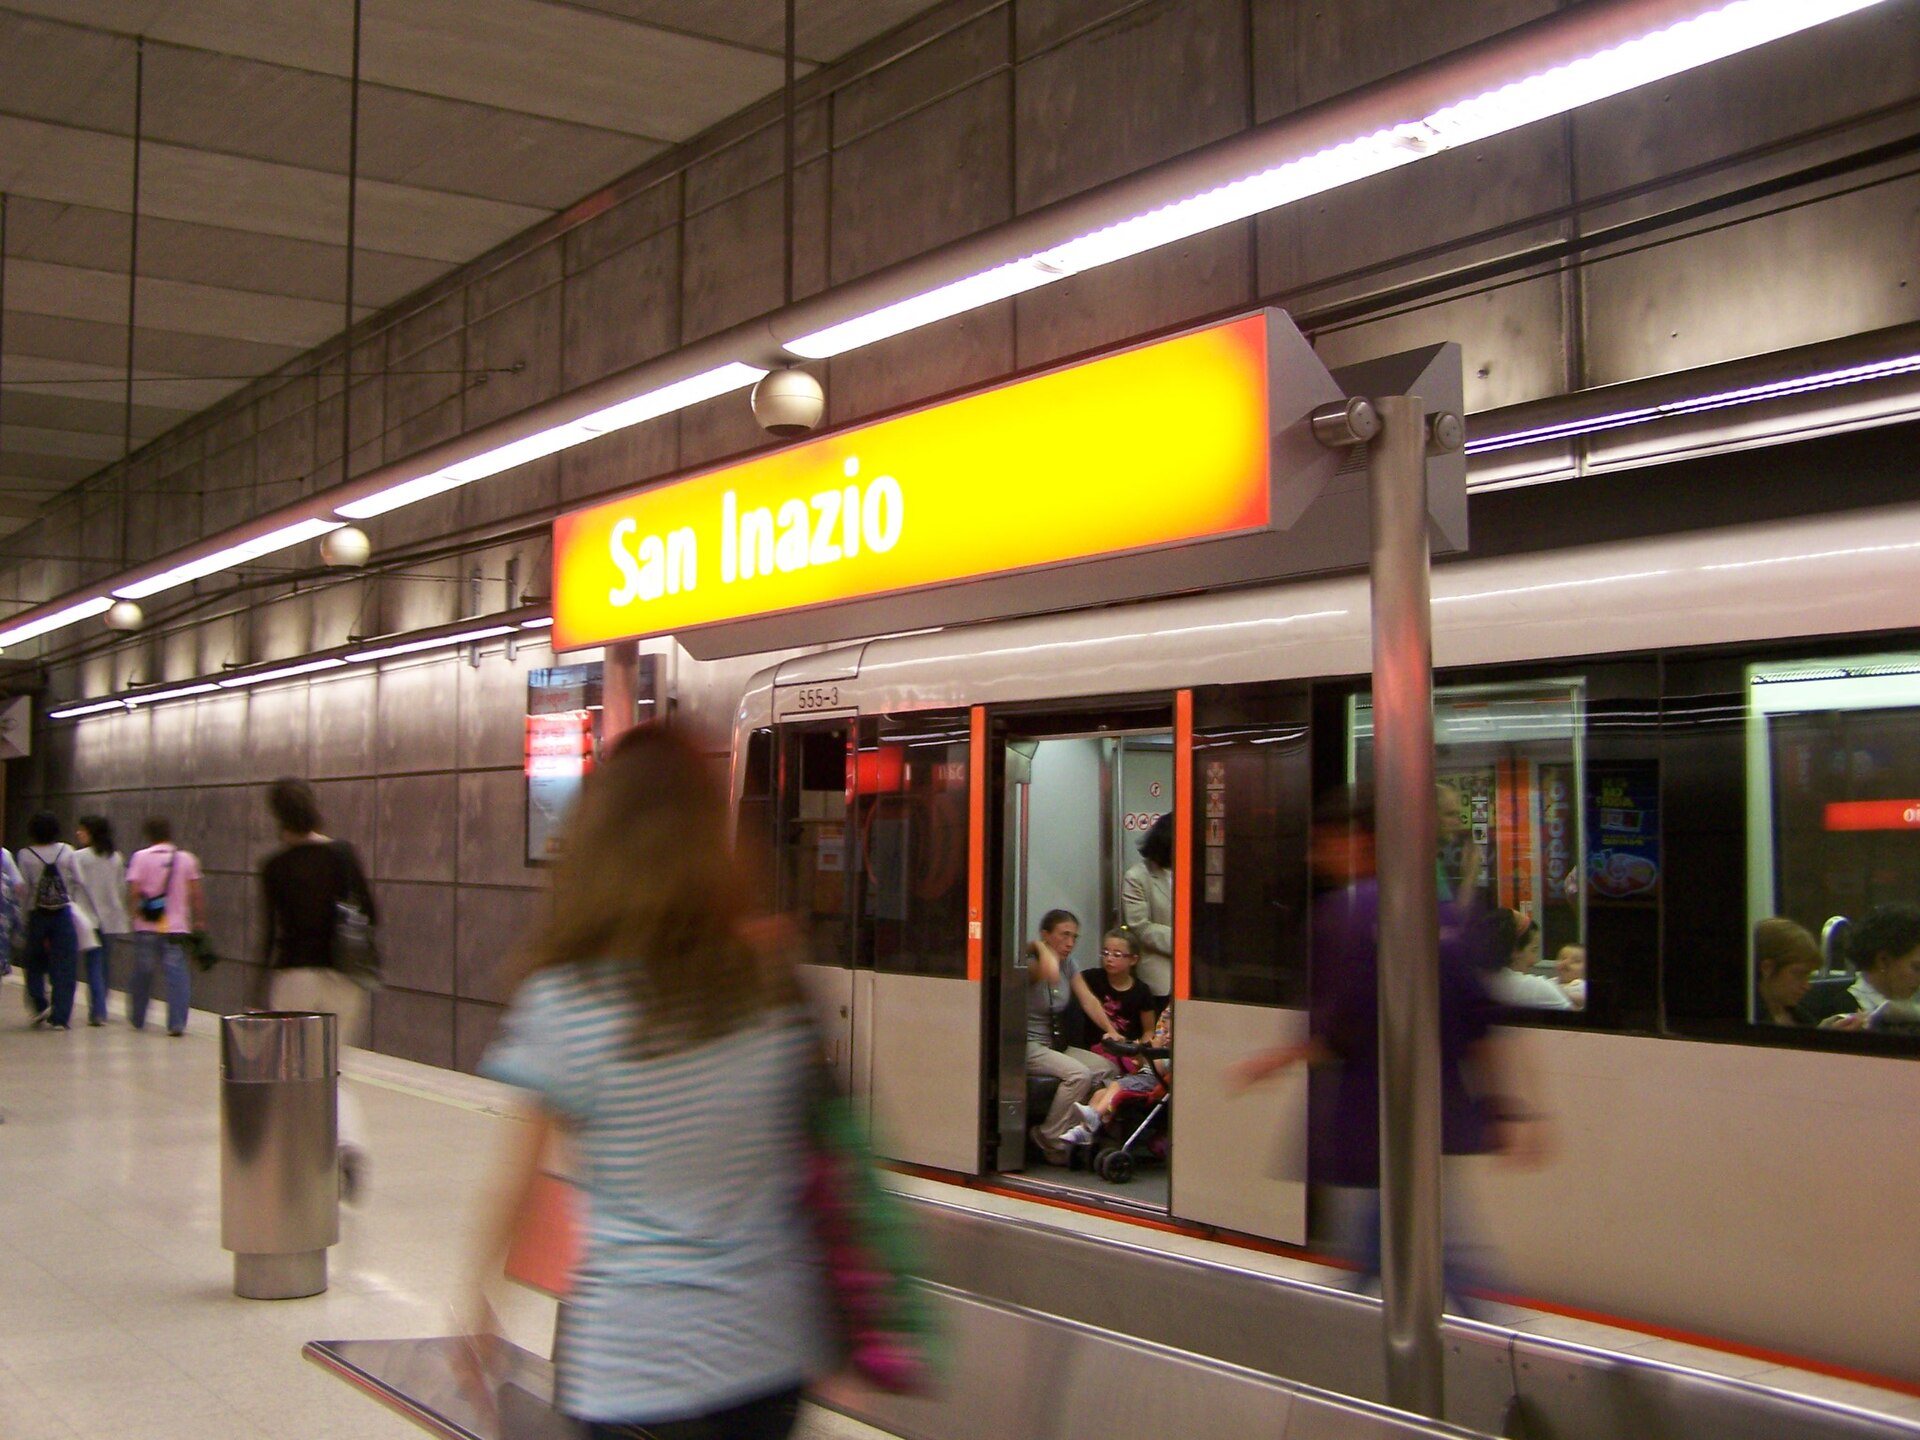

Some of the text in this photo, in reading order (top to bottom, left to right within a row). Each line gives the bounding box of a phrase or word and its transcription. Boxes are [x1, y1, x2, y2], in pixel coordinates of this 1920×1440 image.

[608, 455, 904, 607] San Inazio
[798, 687, 838, 708] 555-3
